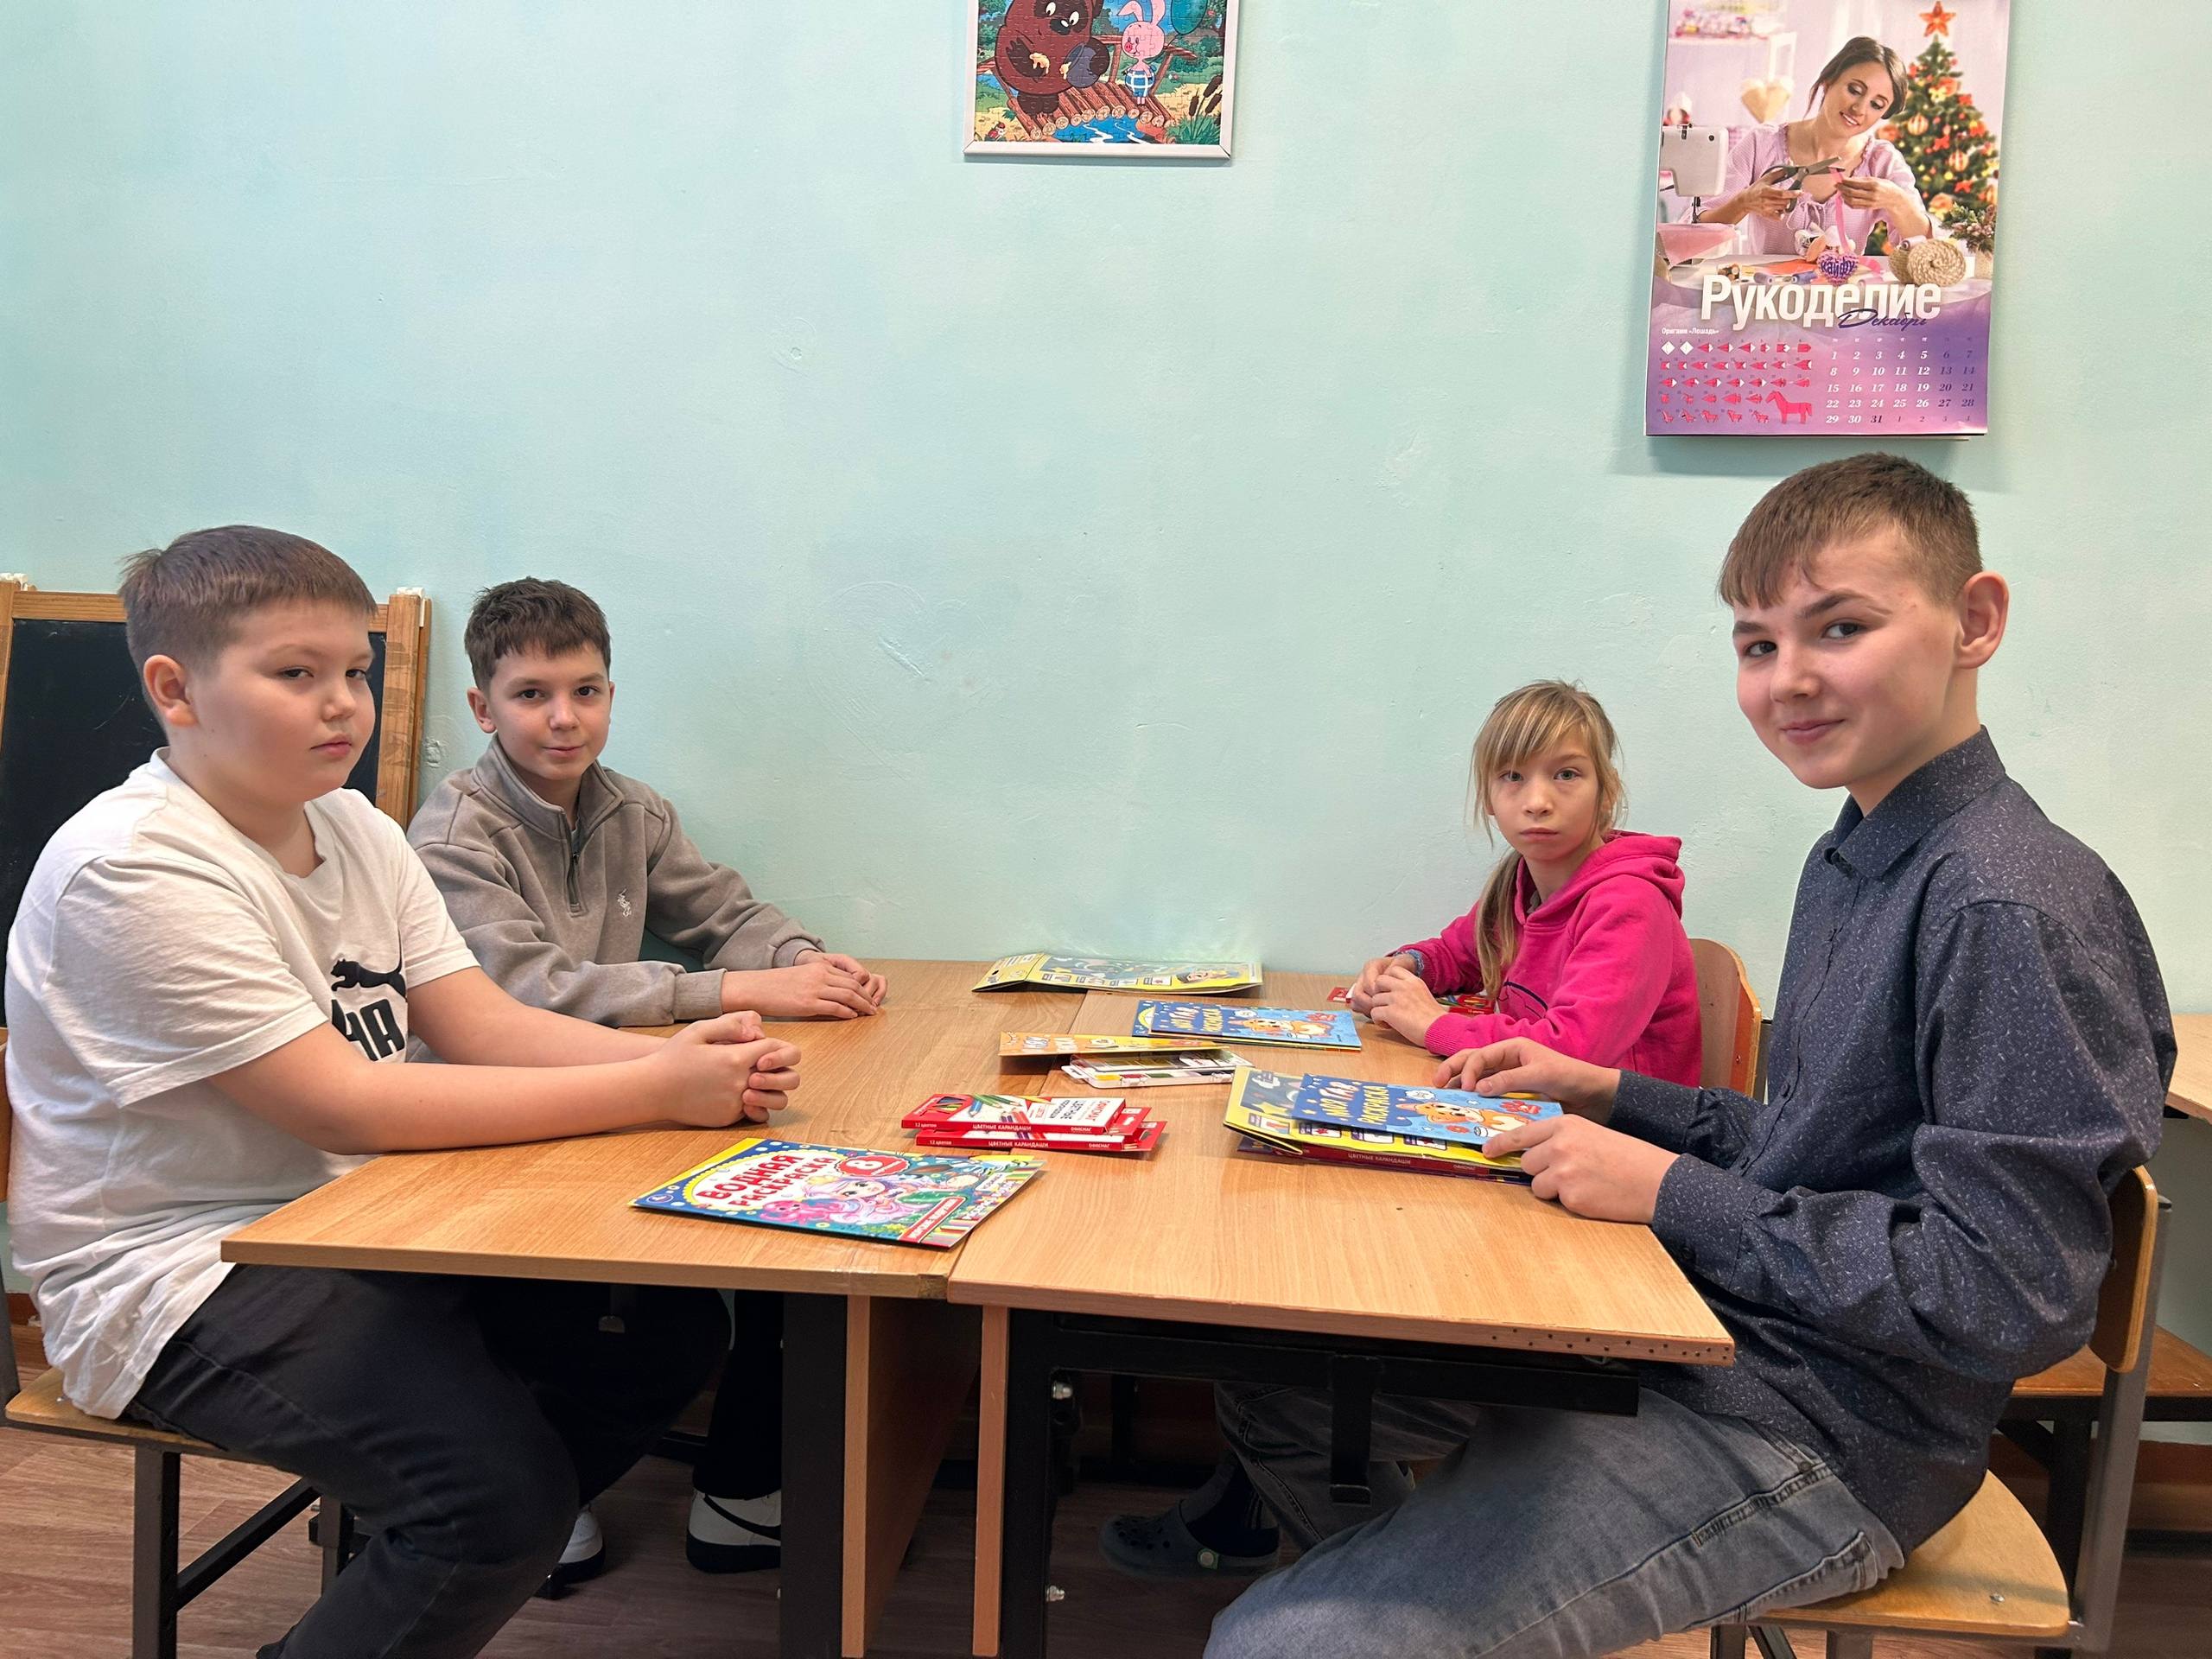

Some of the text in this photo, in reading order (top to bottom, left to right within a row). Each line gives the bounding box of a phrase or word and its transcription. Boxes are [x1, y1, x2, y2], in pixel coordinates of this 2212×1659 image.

[1700, 274, 1942, 331] Рукоделие
[1838, 308, 1928, 332] Декабрь
[1872, 366, 1885, 376] 10
[1894, 366, 1908, 376] 11
[1916, 366, 1930, 376] 12
[1940, 366, 1953, 375] 13
[1827, 383, 1974, 393] 15 16 17 18 19 20 21
[1826, 400, 1840, 409] 22
[1870, 399, 1885, 408] 24
[1892, 399, 1907, 408] 25
[1916, 399, 1929, 408] 26
[1938, 399, 1952, 408] 27
[1961, 398, 1974, 407] 28
[1825, 415, 1840, 423] 29
[1847, 415, 1861, 423] 30
[1870, 415, 1883, 423] 31
[1319, 1081, 1360, 1118] МОЯ ГАВ
[1357, 1084, 1390, 1123] РАСКРАСКА
[847, 1159, 883, 1170] 8
[1347, 1152, 1411, 1165] ЦВЕТНЫЕ КАРАНДАШИ
[696, 1154, 804, 1200] ВОДНАЯ
[728, 1157, 838, 1207] РАСКРАСКА
